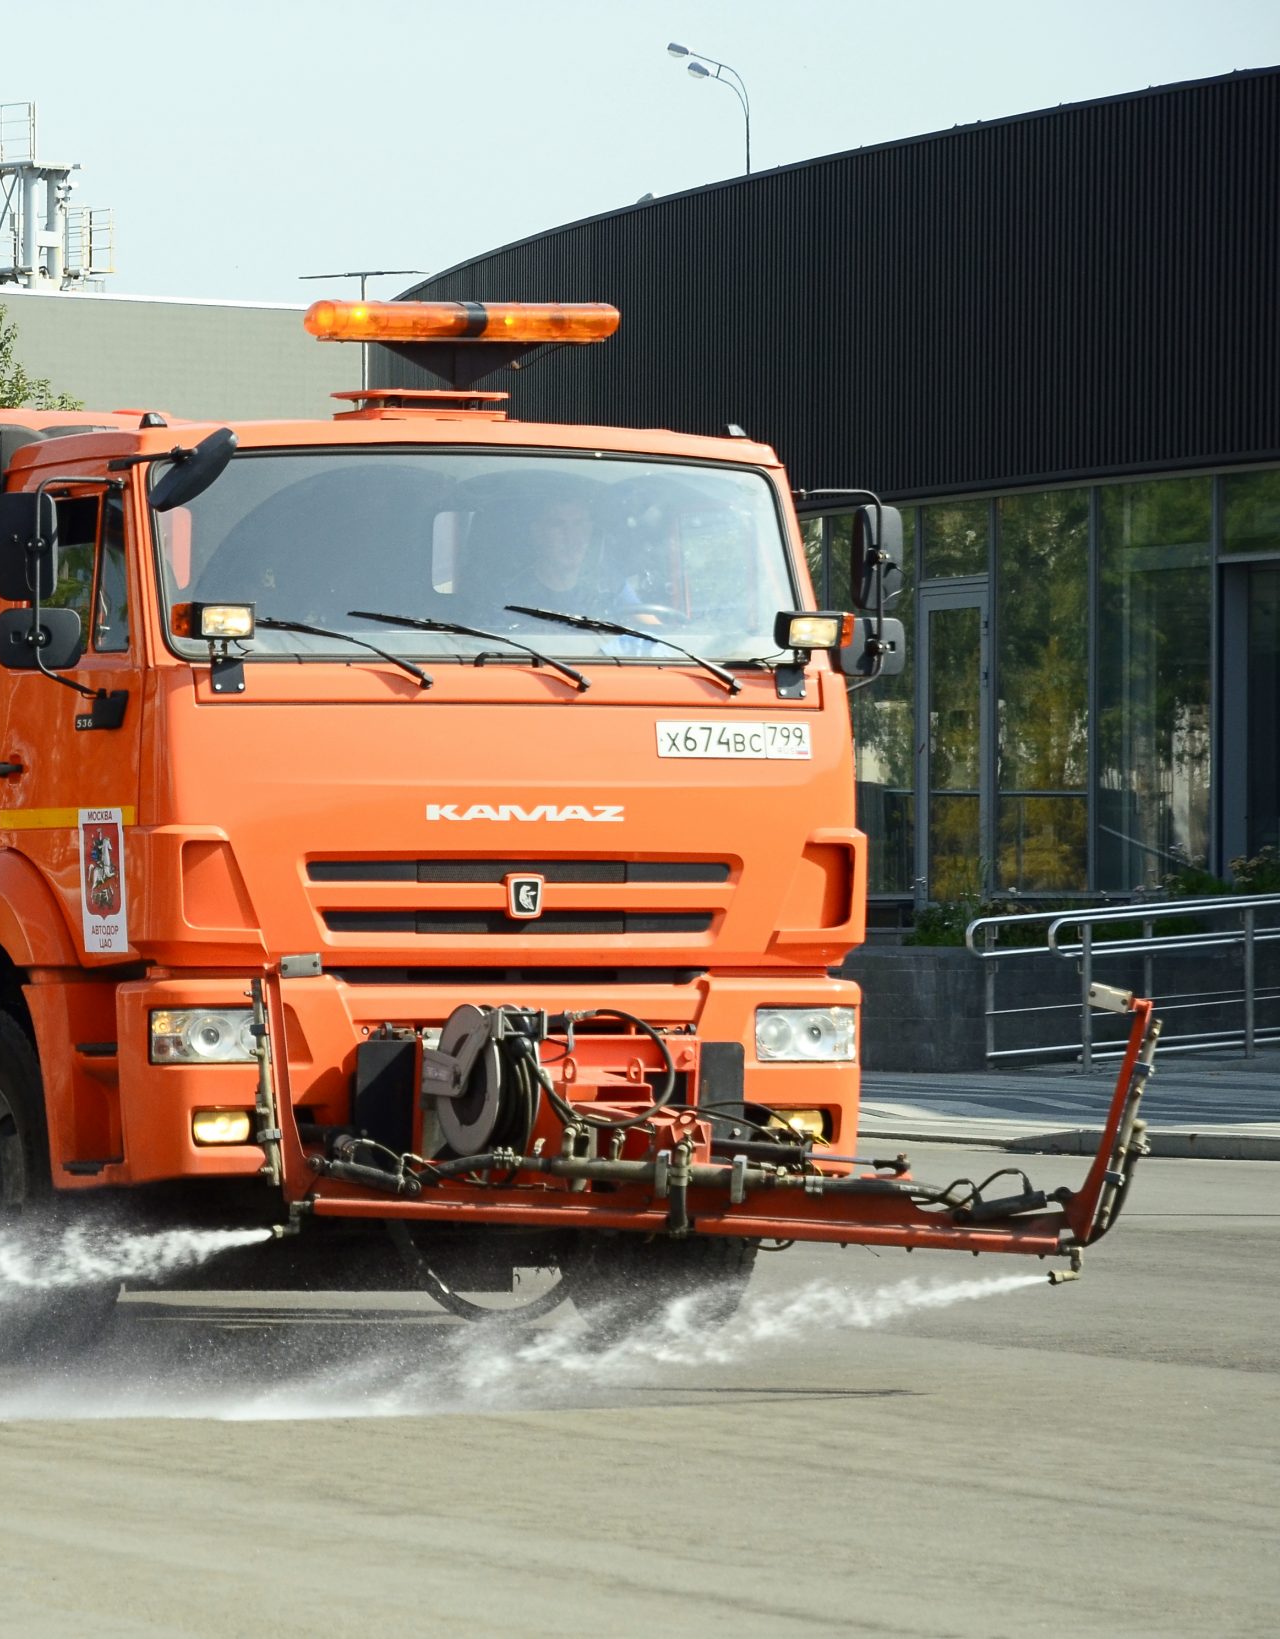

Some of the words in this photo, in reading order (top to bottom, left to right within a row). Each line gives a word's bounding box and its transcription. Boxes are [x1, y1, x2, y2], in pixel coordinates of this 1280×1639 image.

[76, 719, 93, 728] 536
[767, 726, 804, 746] 799
[87, 811, 113, 821] МОСКВА
[426, 804, 625, 822] KAMAZ
[91, 925, 119, 936] АВТОДОР
[99, 938, 113, 949] ЦАО
